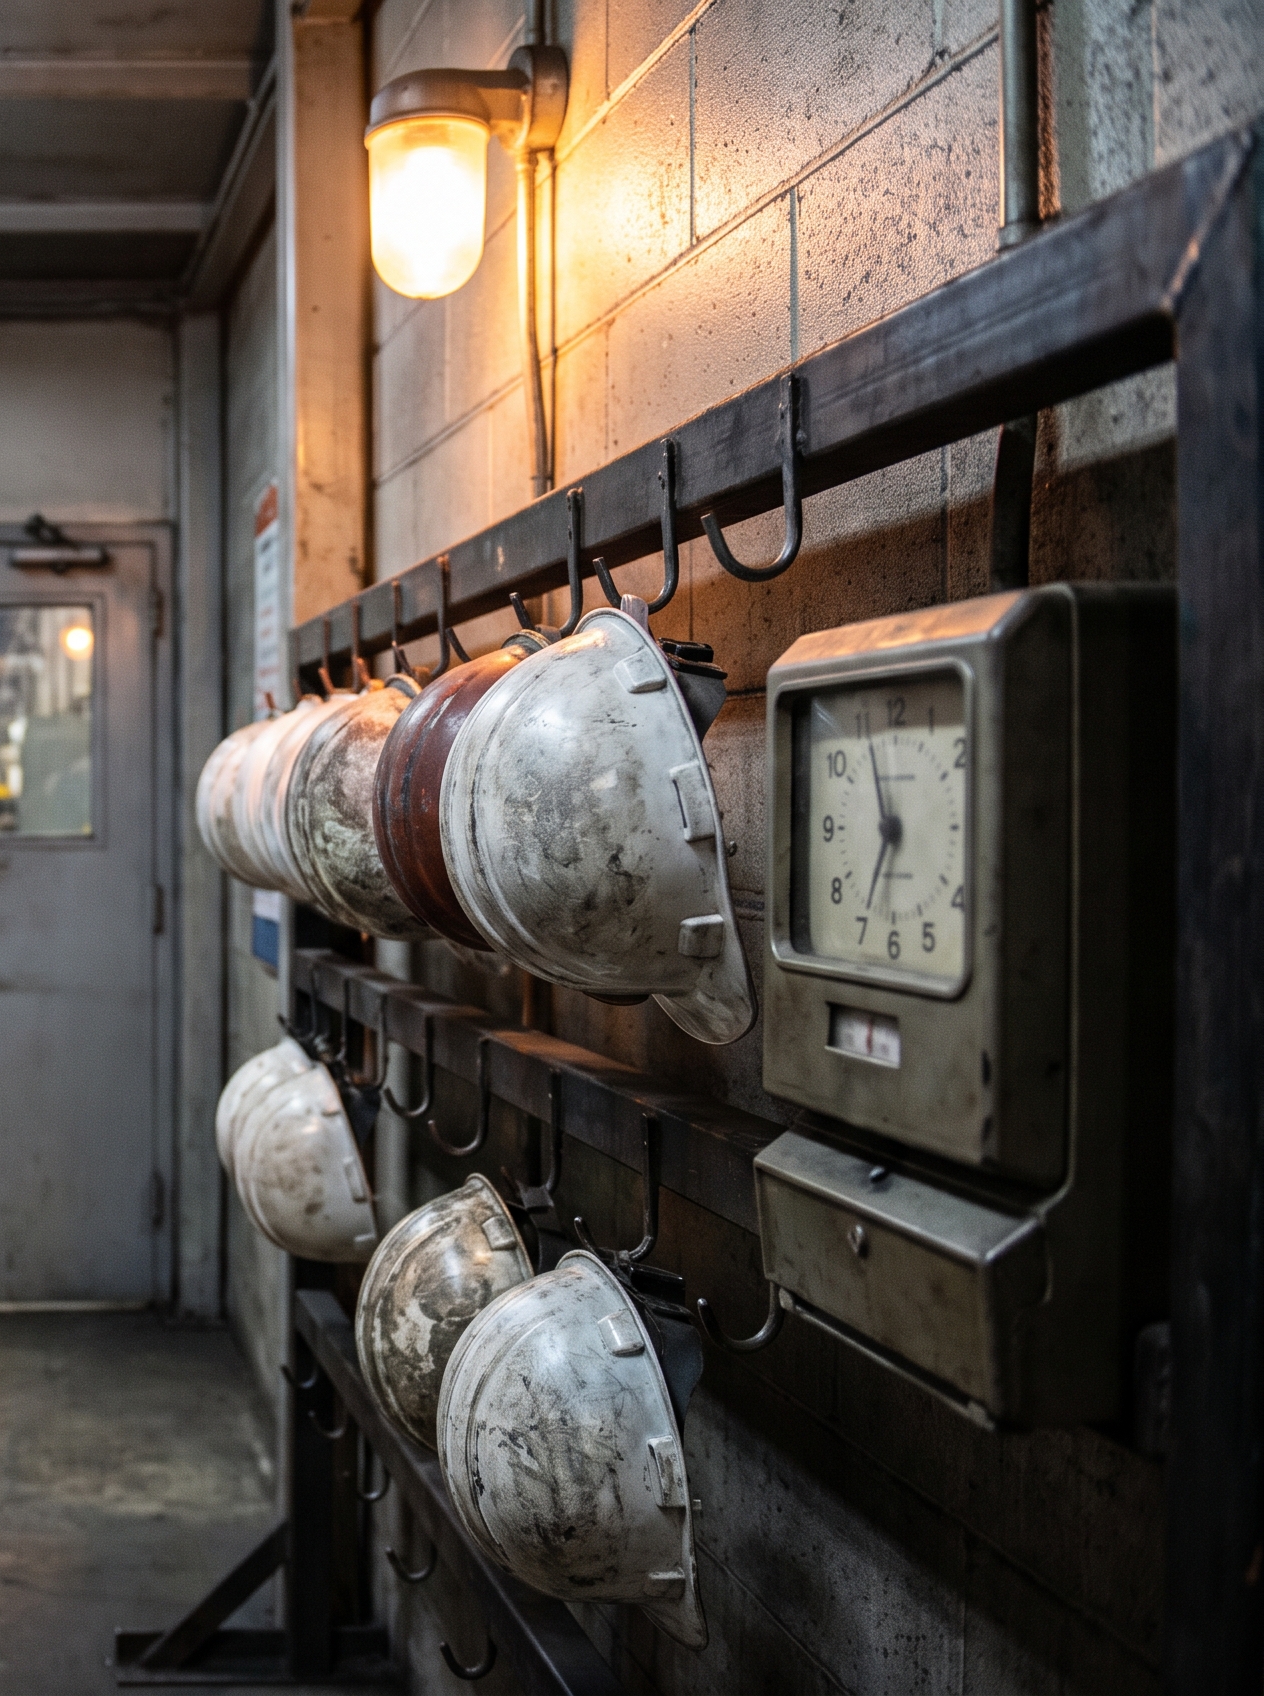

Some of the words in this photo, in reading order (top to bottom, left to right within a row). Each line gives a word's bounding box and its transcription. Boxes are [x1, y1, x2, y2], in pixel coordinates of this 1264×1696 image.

[856, 713, 870, 739] 11
[886, 697, 906, 727] 12
[929, 706, 934, 735] 1
[826, 750, 846, 778] 10
[954, 739, 966, 769] 2
[823, 815, 834, 842] 9
[831, 877, 843, 904] 8
[951, 885, 965, 912] 4
[855, 917, 867, 945] 7
[888, 930, 901, 959] 6
[922, 922, 935, 952] 5
